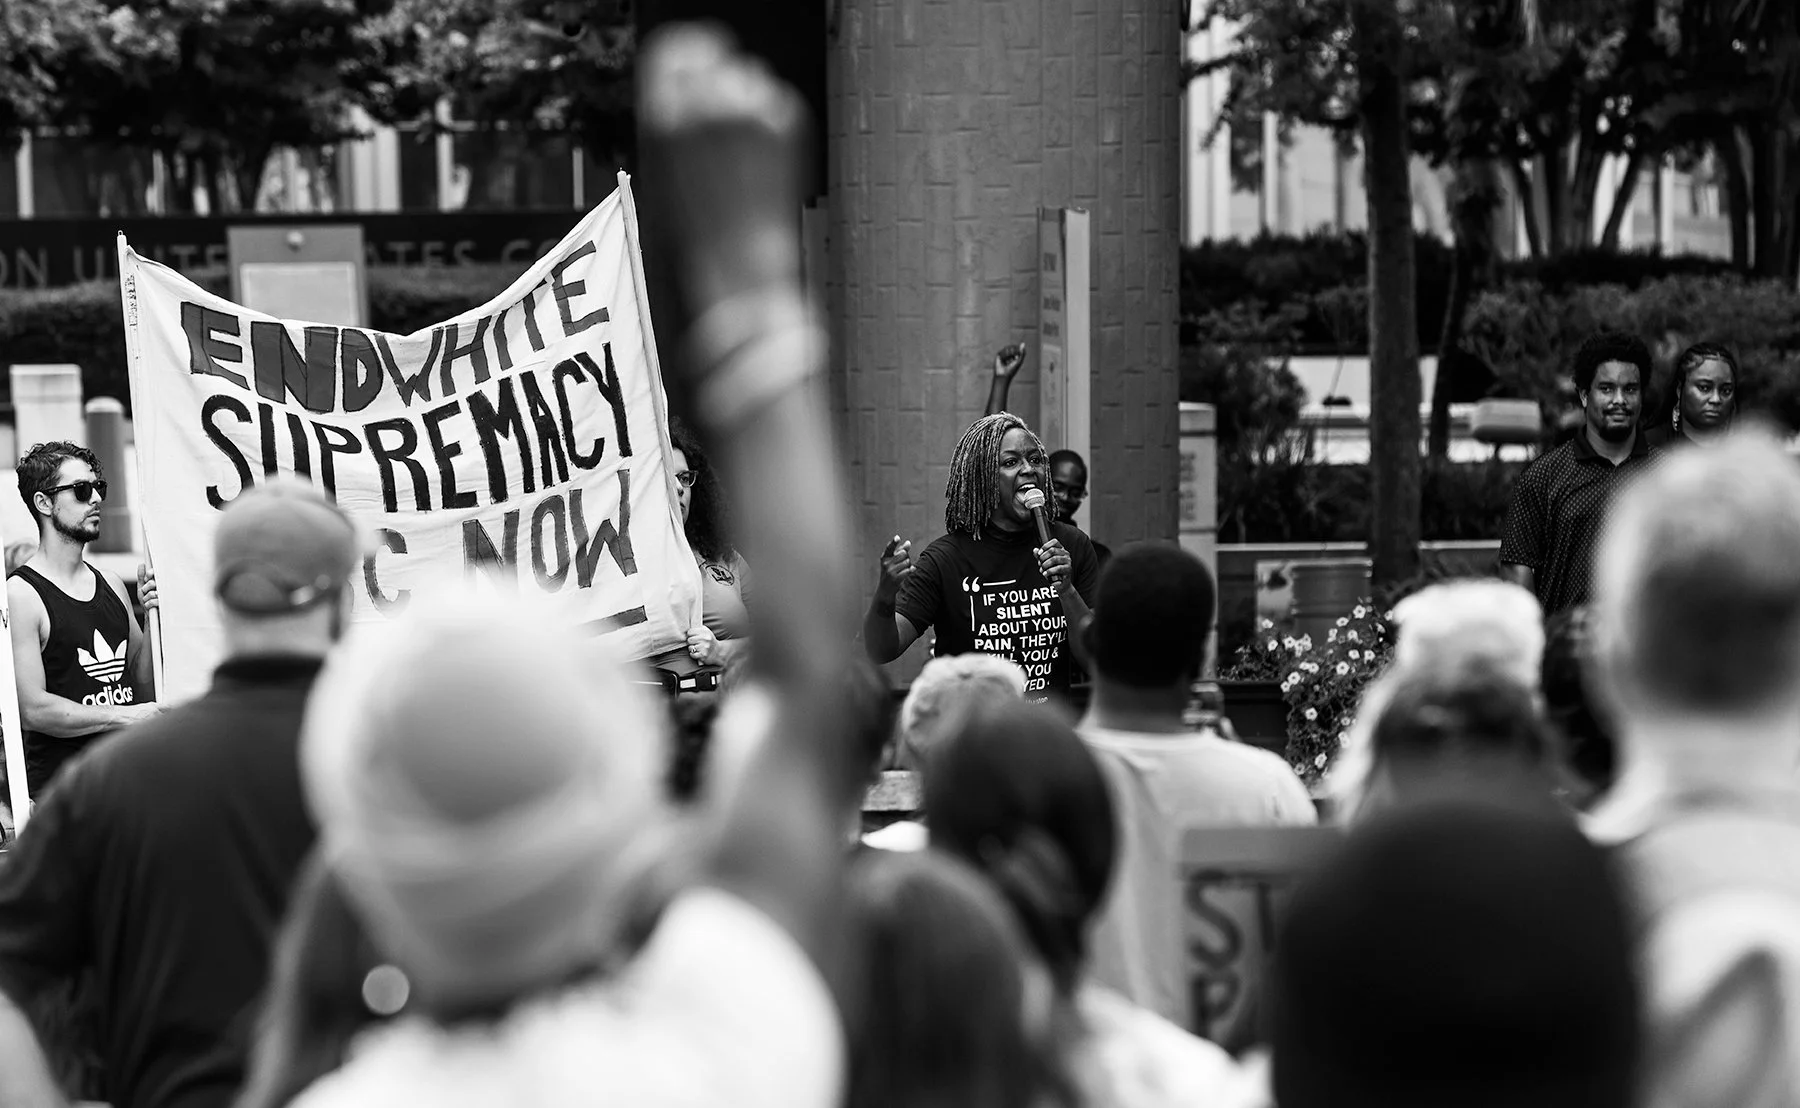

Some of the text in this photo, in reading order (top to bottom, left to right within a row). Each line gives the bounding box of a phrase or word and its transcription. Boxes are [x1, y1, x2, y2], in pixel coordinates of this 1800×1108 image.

[181, 240, 610, 415] END WHITE
[201, 342, 632, 513] SUPREMACY
[462, 468, 638, 593] NOW
[983, 585, 1059, 606] IF YOU ARE
[996, 602, 1051, 619] SILENT
[978, 615, 1067, 636] ABOUT YOUR
[974, 638, 1016, 652] PAIN,
[1022, 648, 1050, 662] YOU
[1051, 646, 1059, 659] &
[1024, 662, 1052, 677] YOU
[82, 684, 134, 706] adidas
